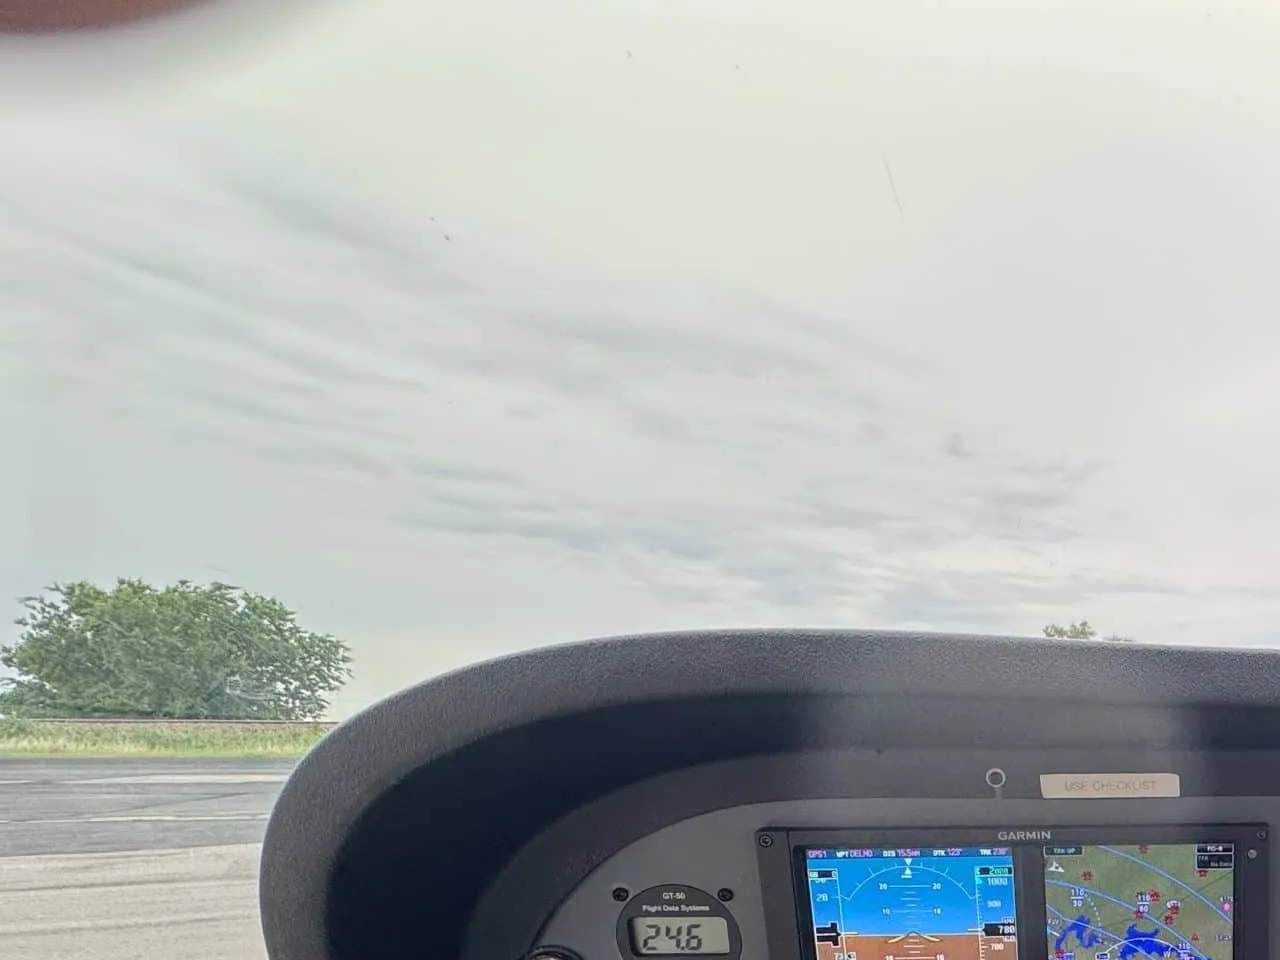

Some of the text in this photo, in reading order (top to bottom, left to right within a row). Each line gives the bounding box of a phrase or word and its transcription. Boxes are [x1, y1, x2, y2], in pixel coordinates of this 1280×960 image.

[1065, 781, 1157, 792] USE CHECKLIST
[998, 832, 1051, 840] GARMIN
[643, 925, 702, 950] 24.6
